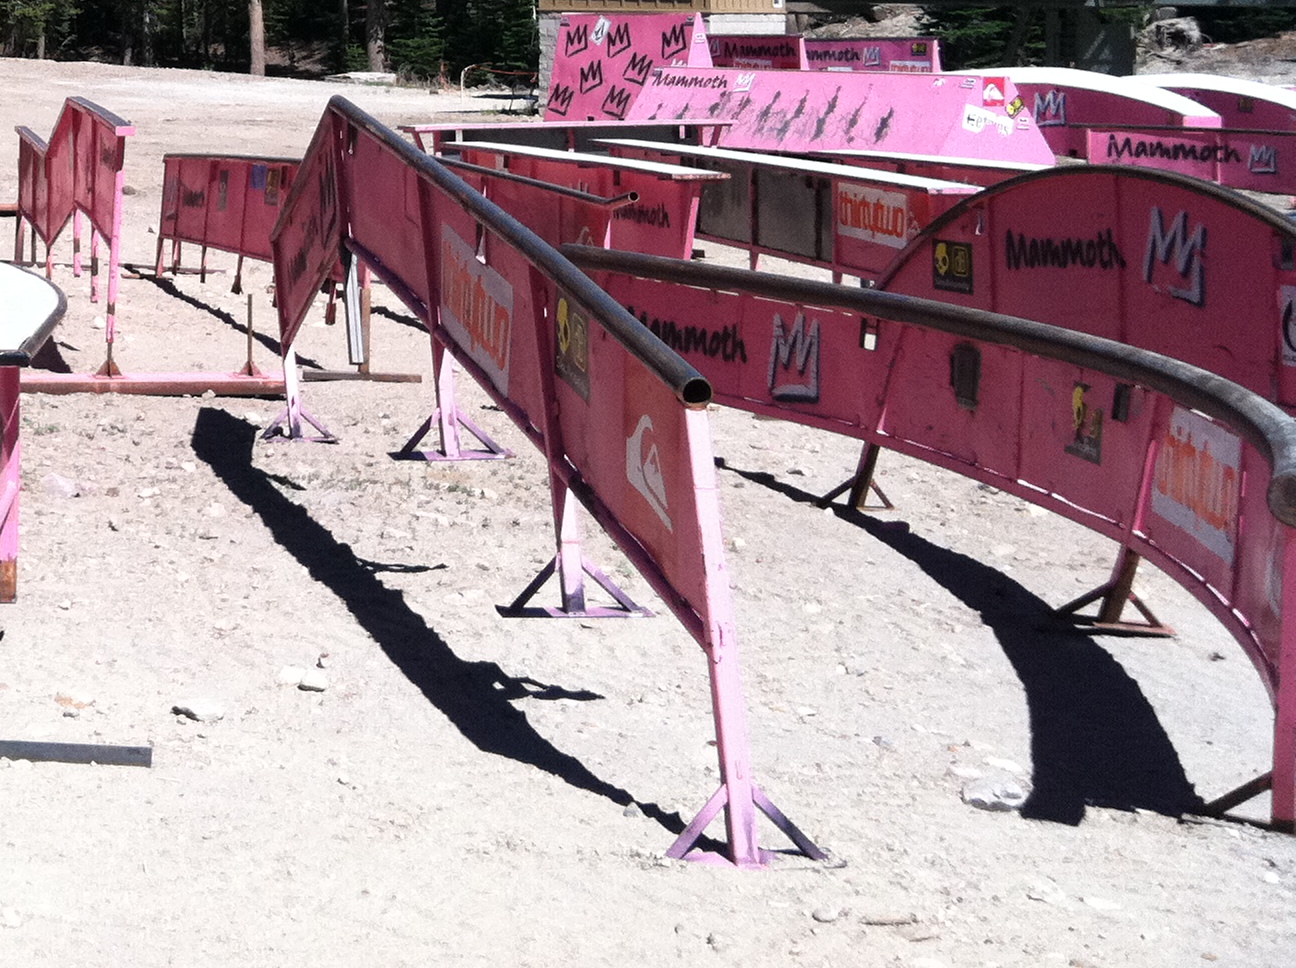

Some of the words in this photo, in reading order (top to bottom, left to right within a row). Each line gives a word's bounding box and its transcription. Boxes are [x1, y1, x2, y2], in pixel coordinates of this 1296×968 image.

[806, 45, 861, 63] ammoth
[653, 72, 728, 90] Mammoth
[1107, 133, 1241, 164] Mammoth
[1005, 228, 1127, 271] Mammoth
